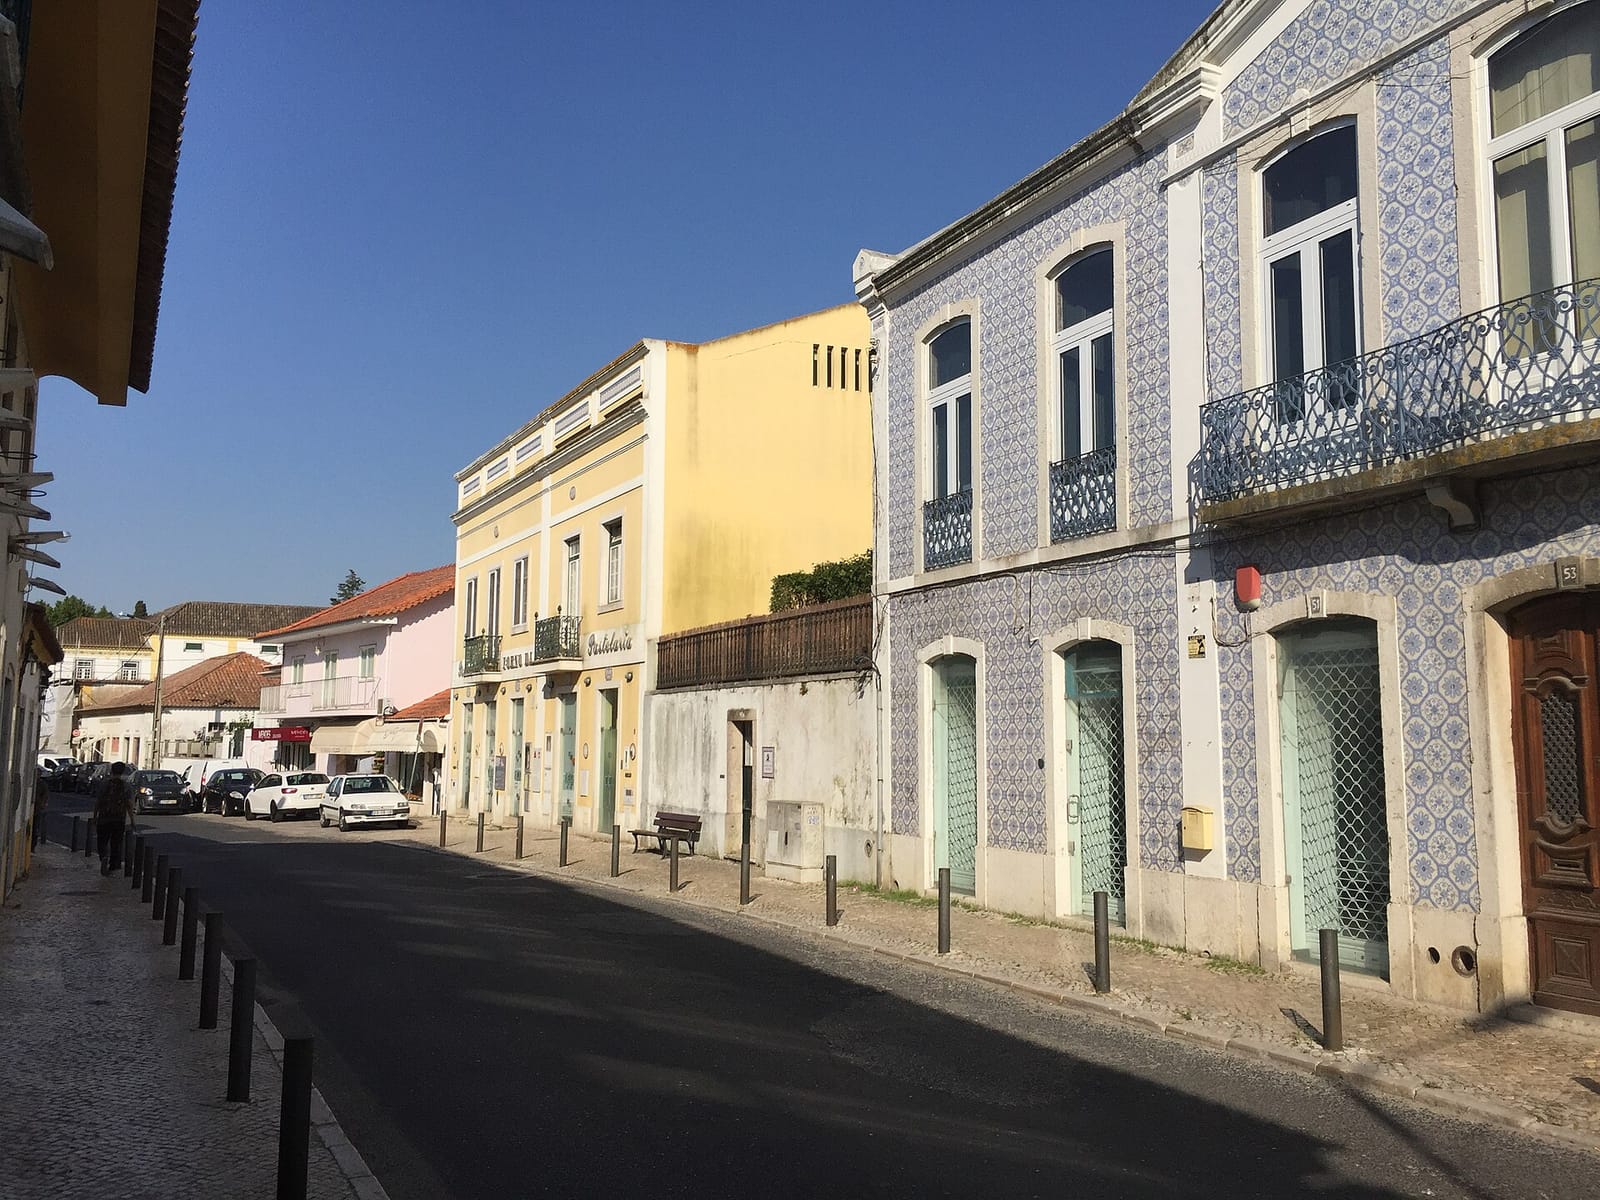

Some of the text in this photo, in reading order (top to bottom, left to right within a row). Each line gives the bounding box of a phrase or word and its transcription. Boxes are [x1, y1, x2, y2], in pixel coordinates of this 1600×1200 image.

[1563, 567, 1577, 580] 53
[1312, 599, 1320, 611] 51
[587, 631, 633, 657] Pastelaria
